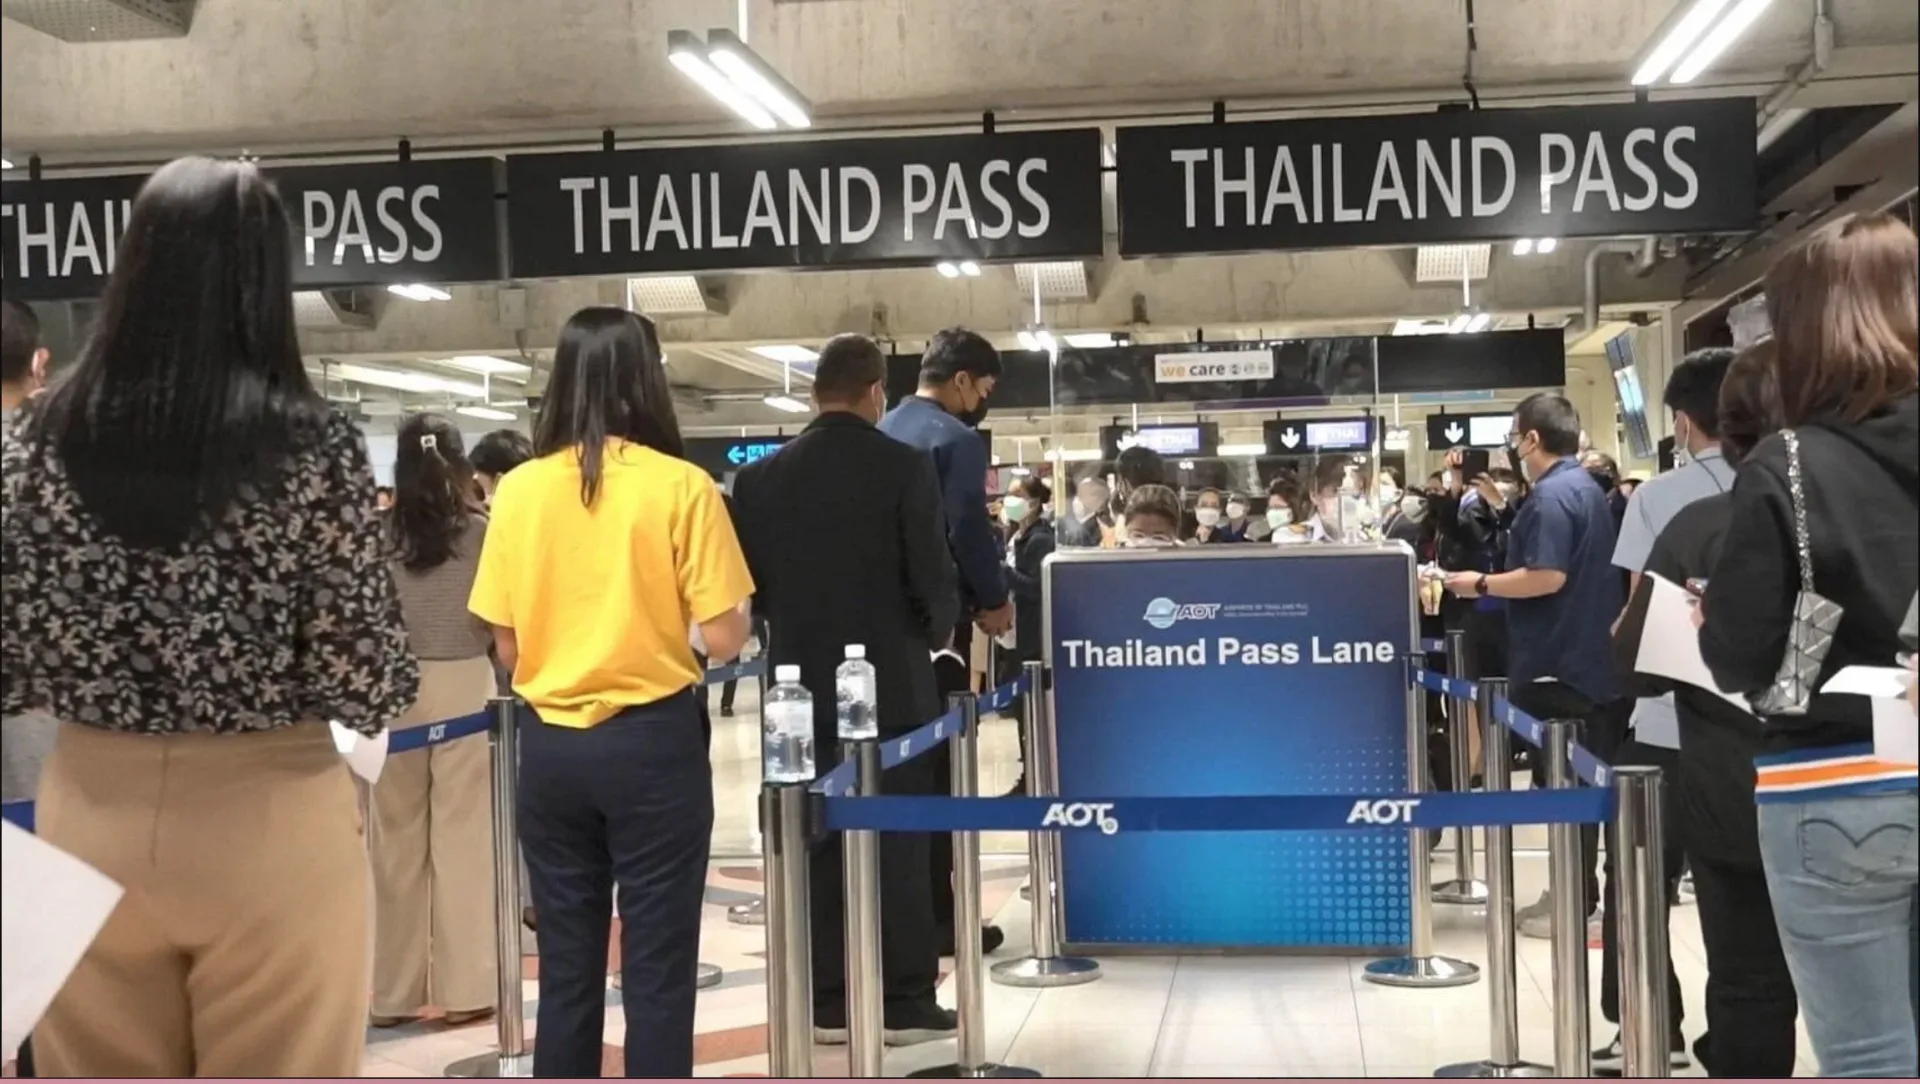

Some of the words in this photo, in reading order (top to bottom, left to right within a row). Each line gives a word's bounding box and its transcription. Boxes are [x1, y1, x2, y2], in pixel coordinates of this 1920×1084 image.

[1171, 136, 1516, 228] THAILAND
[1540, 126, 1699, 215] PASS
[560, 166, 881, 254] THAILAND
[903, 158, 1050, 242] PASS
[304, 185, 443, 266] PASS
[1160, 365, 1186, 377] we
[1189, 364, 1226, 376] care
[1177, 603, 1221, 620] AOT
[1062, 638, 1206, 668] Thailand
[1219, 637, 1300, 665] Pass
[1312, 636, 1394, 664] Lane
[428, 724, 447, 742] AOT
[1042, 802, 1114, 828] AOT
[1346, 799, 1422, 825] AOT
